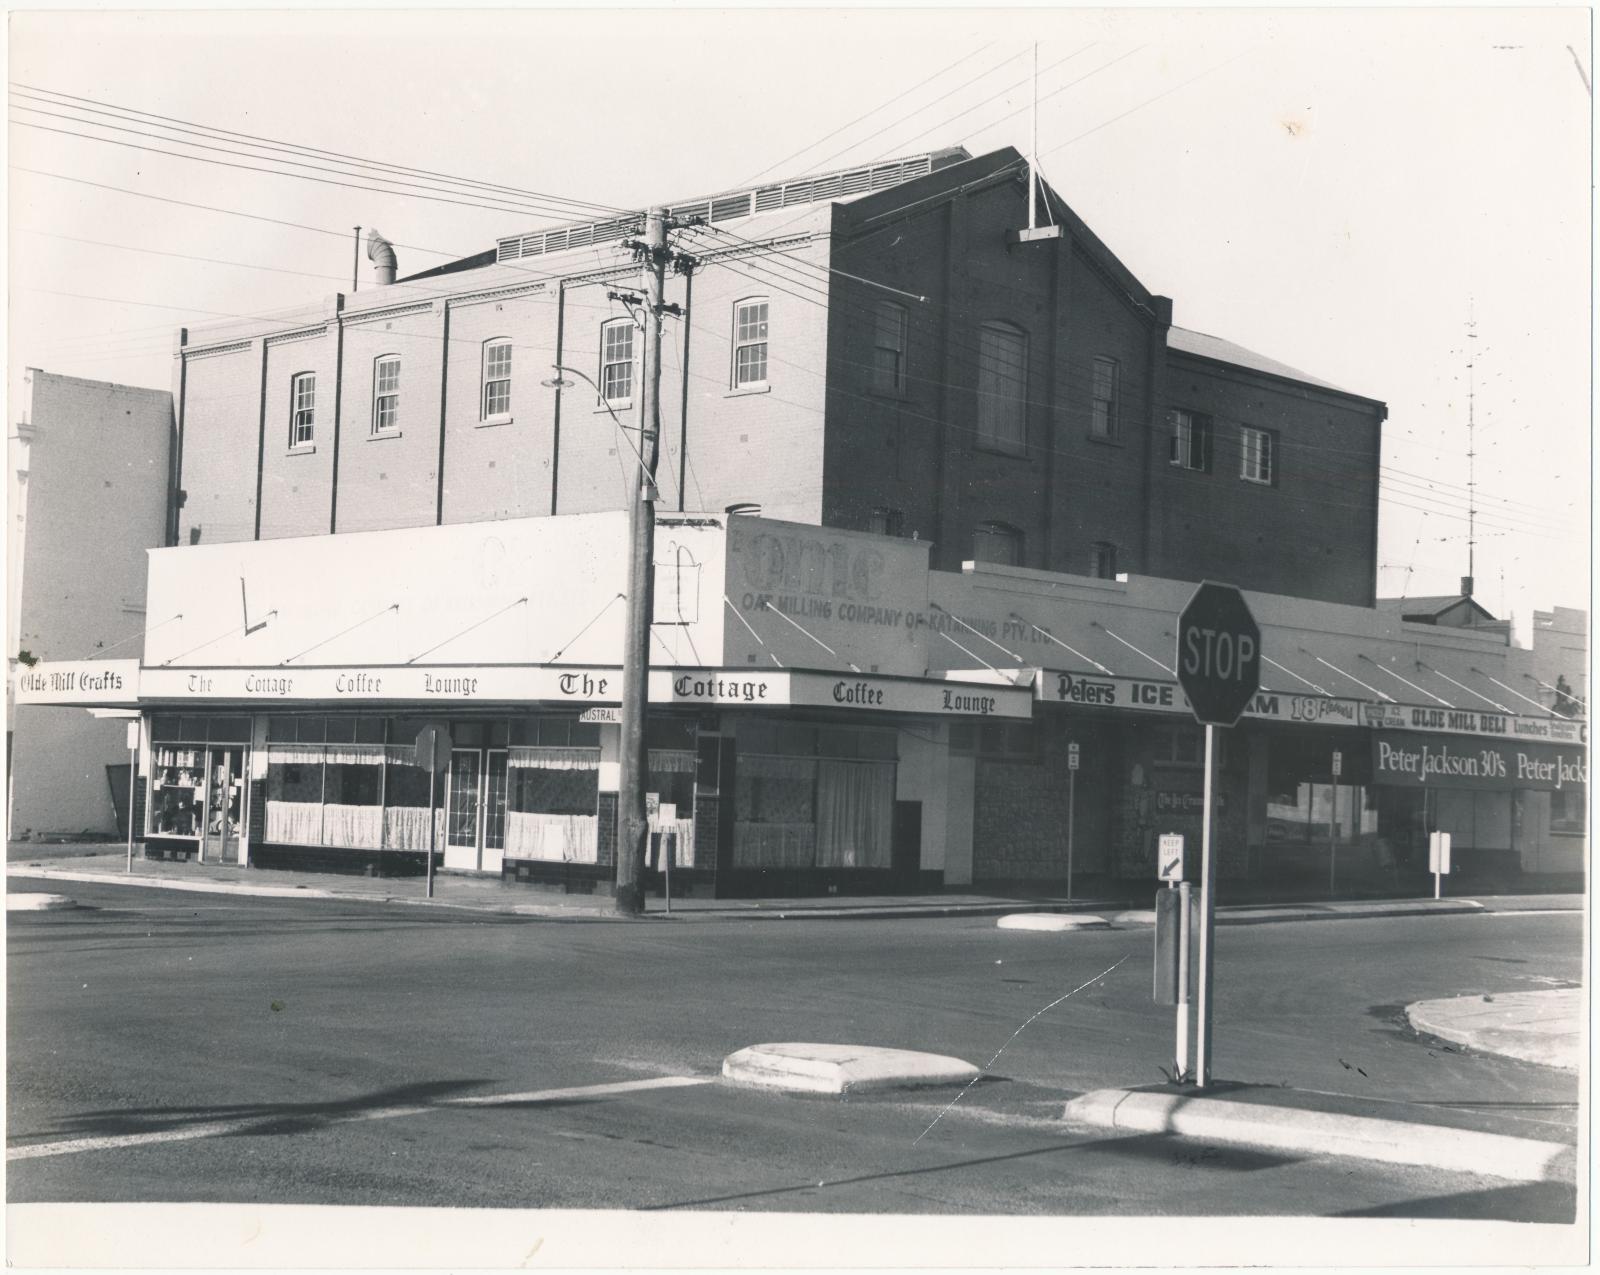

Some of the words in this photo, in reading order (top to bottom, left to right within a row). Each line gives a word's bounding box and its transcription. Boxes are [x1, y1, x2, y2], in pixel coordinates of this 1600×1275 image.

[779, 596, 832, 620] MILLING
[838, 602, 902, 627] COMPANY
[1184, 625, 1254, 681] STOP
[20, 674, 47, 692] Olde
[50, 672, 75, 691] Mill
[79, 671, 123, 692] Crafts
[187, 674, 213, 693] The
[245, 674, 293, 695] Cottage
[335, 674, 382, 693] Coffee
[424, 674, 478, 696] Lounge
[558, 673, 608, 697] The
[674, 675, 768, 701] Cottage
[832, 681, 884, 706] Coffee
[942, 689, 996, 715] Lounge
[1058, 673, 1115, 704] Peters
[1131, 683, 1173, 706] ICE
[1291, 696, 1317, 721] 18
[580, 708, 617, 721] AUSTRAL
[1411, 708, 1445, 730] OLDE
[1448, 711, 1477, 732] MILL
[1480, 715, 1507, 734] DELI
[1514, 718, 1548, 737] Lunches
[1378, 741, 1419, 773] Peter
[1419, 745, 1478, 782] Jackson
[1480, 750, 1507, 778] 30's
[1516, 752, 1555, 780] Peter
[1163, 848, 1179, 856] LEFT
